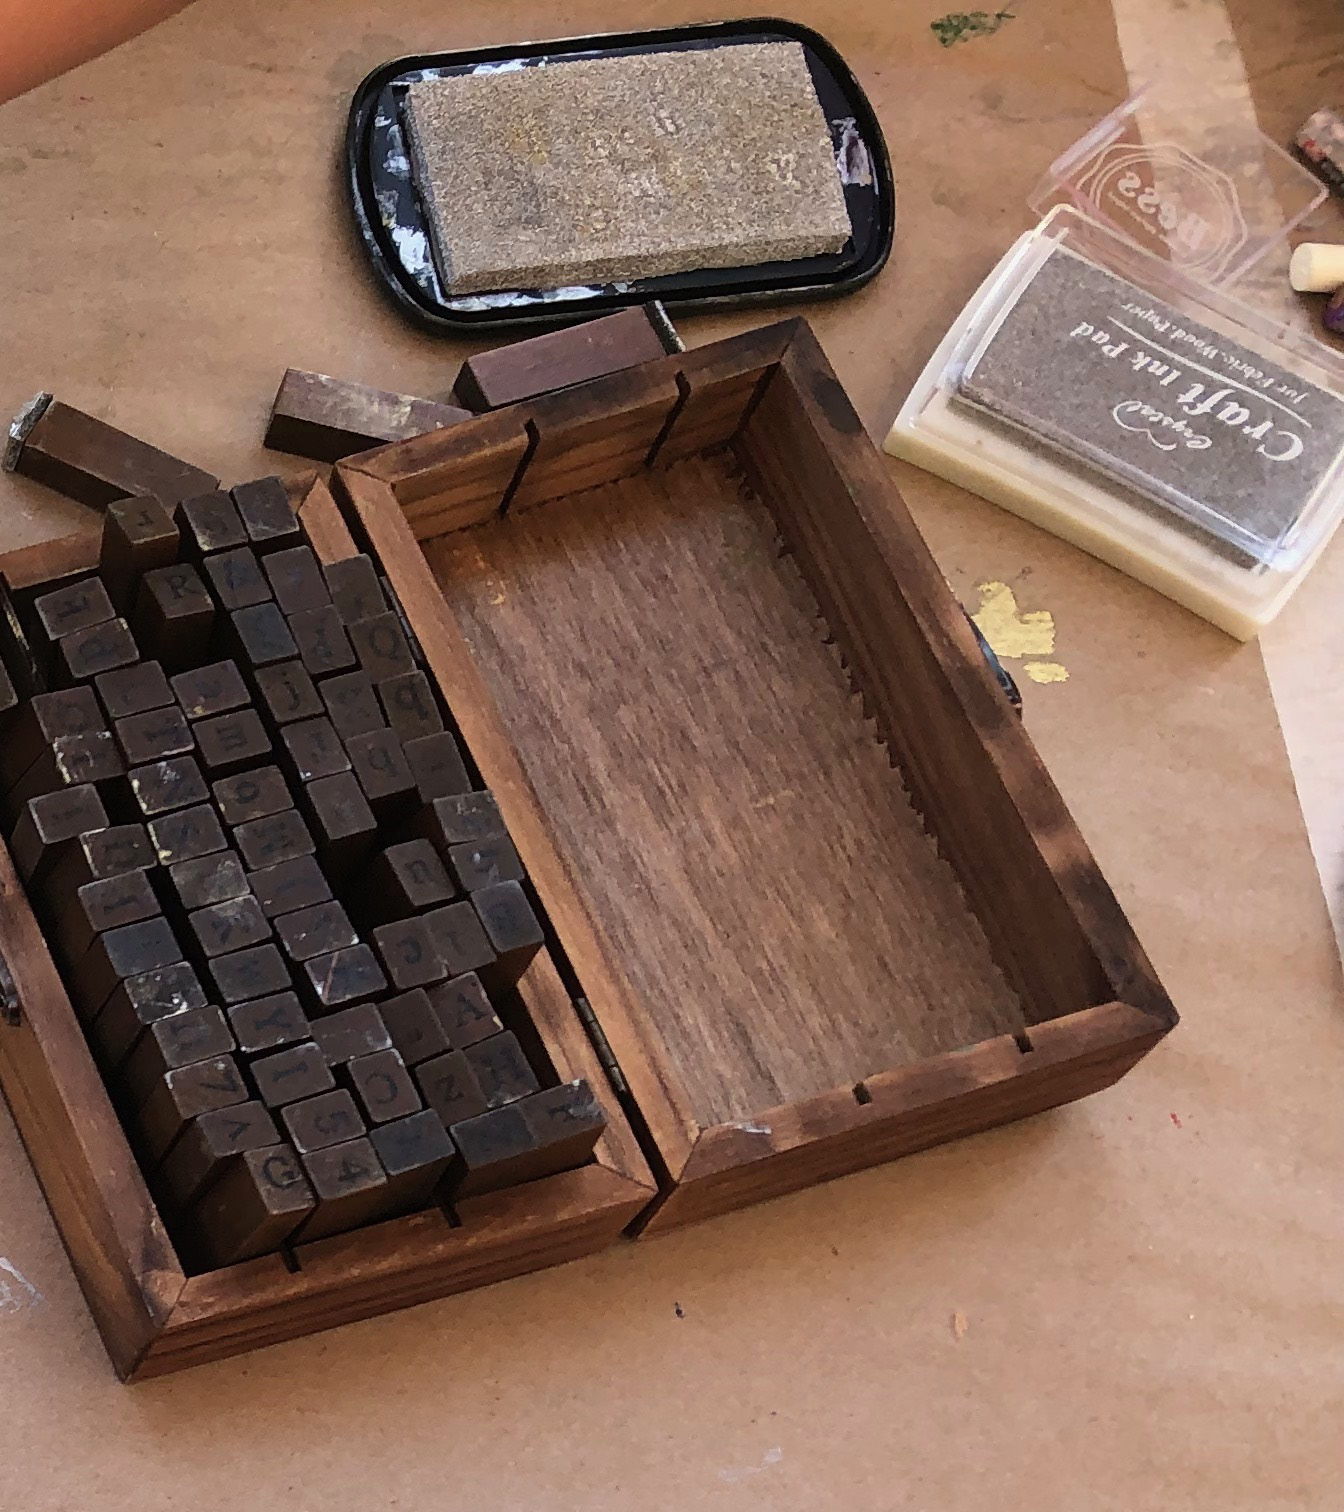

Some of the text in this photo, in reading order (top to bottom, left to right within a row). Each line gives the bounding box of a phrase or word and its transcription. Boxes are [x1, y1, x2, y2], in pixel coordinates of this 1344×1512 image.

[1068, 318, 1305, 463] Craft Ink Pad
